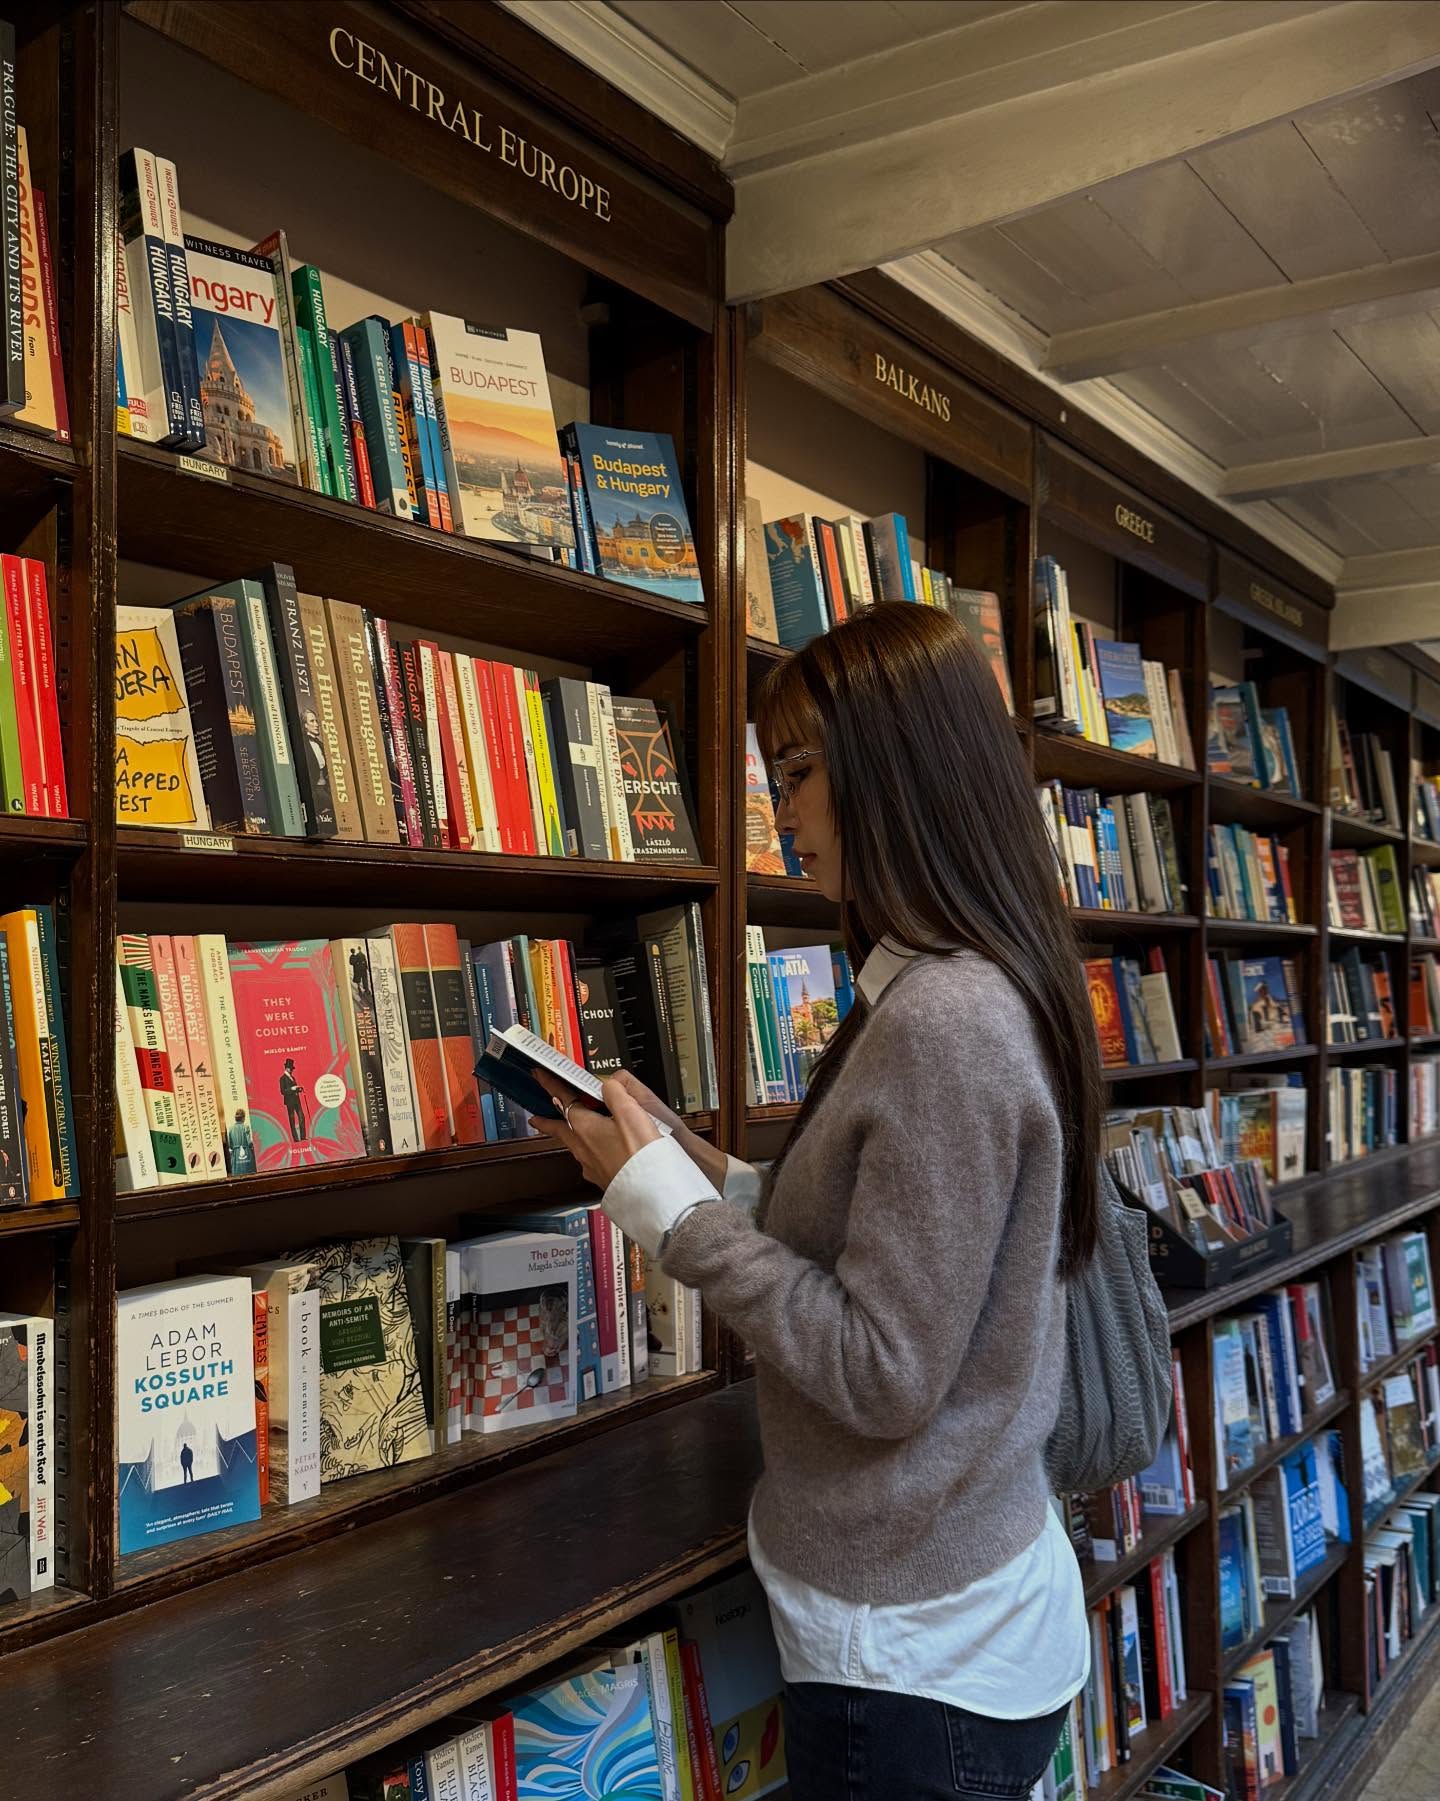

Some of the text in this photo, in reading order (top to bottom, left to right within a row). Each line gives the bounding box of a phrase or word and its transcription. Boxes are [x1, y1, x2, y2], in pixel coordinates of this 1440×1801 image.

[329, 27, 612, 222] CENTRAL EUROPE
[143, 158, 159, 228] INSIGHT GUIDES
[164, 168, 179, 237] INSIGHT GUIDES
[3, 61, 23, 362] PRAGUE: THE CITY AND ITS RIVER
[185, 238, 272, 270] WITNESS TRAVEL
[150, 246, 174, 322] HUNGARY
[171, 254, 193, 329] HUNGARY
[312, 288, 328, 348] HUNGARY
[28, 336, 36, 357] from
[346, 364, 360, 418] HUNGARY
[408, 364, 425, 418] BUDAPEST
[421, 368, 437, 421] BUDAPEST
[450, 366, 537, 398] BUDAPEST
[875, 353, 951, 423] BALKANS
[375, 354, 398, 454] SECRET BUDAPEST
[435, 397, 450, 452] BUDAPEST
[311, 431, 321, 467] BALATON
[317, 427, 327, 462] BUDAPEST
[335, 384, 357, 501] WALKING IN HUNGARY
[394, 392, 416, 503] BUDAPEST
[182, 457, 227, 478] HUNGARY
[592, 454, 668, 478] Budapest
[596, 474, 671, 498] & Hungary
[1114, 503, 1155, 544] GREECE
[15, 619, 27, 686] LETTERS TO MILENA
[38, 622, 46, 649] LETTERS
[286, 599, 311, 697] FRANZ LISZT
[308, 624, 327, 668] The
[41, 651, 48, 661] TO
[220, 612, 245, 697] BUDAPEST
[403, 650, 422, 722] HUNGARY
[462, 667, 473, 702] Katalin
[272, 712, 285, 758] HUNGARY
[348, 631, 386, 806] The Hungarians
[317, 671, 349, 803] Hungarians
[395, 729, 411, 782] BUDAPEST
[607, 721, 624, 799] TWELVE DAYS
[240, 747, 254, 802] SEBESTYEN
[250, 757, 261, 792] VICTOR
[421, 755, 437, 829] NORMAN STONE
[30, 783, 40, 812] VINTAGE
[54, 785, 62, 814] VINTAGE
[319, 814, 333, 823] Yale
[186, 836, 231, 848] HUNGARY
[752, 967, 760, 998] Croatia
[761, 967, 770, 998] Croatia
[158, 973, 178, 1042] BUDAPEST
[180, 973, 200, 1042] BUDAPEST
[263, 997, 292, 1007] THEY
[264, 1011, 295, 1022] WERE
[583, 1008, 614, 1020] CHOLY
[135, 972, 165, 1087] THE NAMES HEARD LONG AGO
[221, 1014, 230, 1034] ACTS
[224, 1036, 232, 1047] OF
[255, 1025, 309, 1038] COUNTED
[356, 1012, 368, 1051] BRIDGE
[362, 1006, 376, 1056] INVISIBLE
[588, 1035, 594, 1045] F
[780, 1015, 788, 1055] CROATIA
[787, 1015, 796, 1054] CROATIA
[41, 1042, 51, 1082] KAFKA
[51, 1043, 63, 1097] WINTER IN
[227, 1052, 234, 1064] MY
[590, 1057, 622, 1069] TANCE
[228, 1064, 239, 1102] MOTHER
[366, 1072, 378, 1128] ORRINGER
[376, 1086, 384, 1113] JULIE
[1, 1107, 10, 1140] STORIES
[153, 1100, 165, 1125] WILSON
[163, 1095, 174, 1127] JONATHAN
[177, 1085, 192, 1149] DE BASTION
[185, 1091, 198, 1142] ROXANNE
[198, 1084, 213, 1148] DE BASTION
[206, 1090, 218, 1141] ROXANNE
[289, 1147, 310, 1155] VOLUME
[400, 1139, 410, 1149] A
[61, 1144, 72, 1186] PARTITA
[137, 1150, 147, 1178] VINTAGE
[528, 1256, 575, 1273] Magda Szabó
[530, 1247, 575, 1261] The Door
[435, 1266, 443, 1296] IZA'S
[616, 1261, 625, 1308] Vampire
[138, 1310, 158, 1320] TIMES
[160, 1306, 179, 1316] BOOK
[206, 1296, 234, 1307] SUMMER
[322, 1303, 374, 1320] MEMOIRS OF AN
[329, 1314, 369, 1327] ANTI-SEMITE
[150, 1322, 217, 1350] ADAM
[255, 1313, 267, 1364] EMBERS
[301, 1312, 312, 1358] book
[146, 1341, 222, 1371] LEBOR
[134, 1359, 234, 1394] KOSSUTH
[37, 1333, 47, 1485] Mendelssohn is on Roof
[140, 1380, 229, 1413] SQUARE
[37, 1514, 47, 1542] Weil
[207, 1510, 221, 1518] DAILY
[601, 1677, 639, 1696] MAGRIS
[432, 1746, 455, 1763] Andrew
[462, 1731, 484, 1745] Andrew
[465, 1741, 484, 1756] Eames
[414, 1757, 424, 1793] Tony
[436, 1756, 455, 1771] Eames
[476, 1753, 488, 1789] BLUE
[447, 1769, 458, 1801] BLUE
